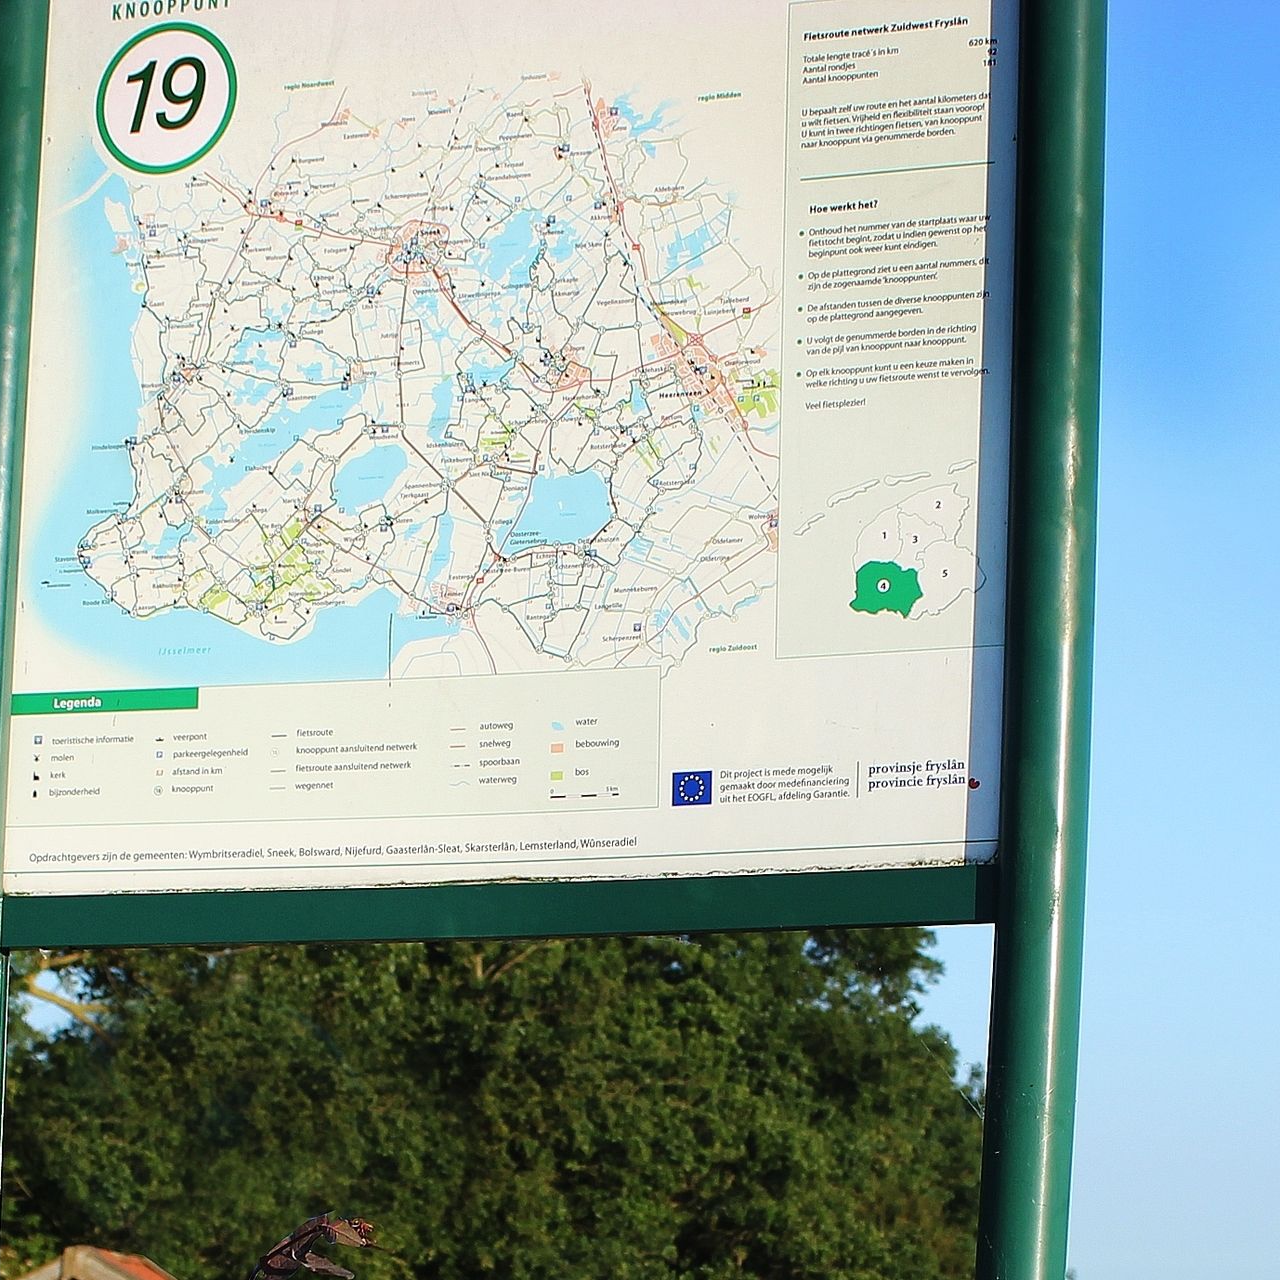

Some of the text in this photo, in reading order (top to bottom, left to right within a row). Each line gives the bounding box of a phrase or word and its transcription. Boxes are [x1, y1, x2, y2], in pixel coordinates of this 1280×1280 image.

[803, 29, 849, 42] Fietsroute
[851, 24, 889, 37] netwerk
[890, 20, 932, 33] Zuidwest
[968, 37, 983, 47] 620
[803, 53, 825, 63] Totale
[826, 51, 850, 62] lengte
[803, 61, 856, 74] Aantal rondjes
[802, 70, 879, 85] Aantal knooppunten
[127, 56, 207, 134] 19
[809, 105, 837, 117] bepaalt
[838, 104, 852, 113] zelf
[866, 101, 886, 111] route
[898, 99, 911, 108] het
[912, 96, 936, 107] aantal
[937, 94, 977, 104] kilometers
[807, 118, 822, 127] wilt
[851, 112, 880, 124] Vrijheid
[893, 108, 932, 119] flexibiliteit
[933, 107, 954, 116] staan
[808, 128, 825, 138] kunt
[834, 127, 854, 135] twee
[855, 123, 894, 133] richtingen
[924, 119, 938, 127] van
[939, 114, 983, 126] knooppunt
[801, 141, 817, 149] naar
[818, 136, 860, 148] knooppunt
[861, 135, 872, 144] via
[873, 130, 925, 145] genummerde
[810, 199, 878, 214] Hoe werkt het?
[829, 309, 874, 323] plattegrond
[806, 348, 820, 356] van
[832, 344, 844, 356] pijl
[845, 345, 859, 353] van
[860, 340, 902, 352] knooppunt
[904, 340, 921, 348] naar
[806, 400, 821, 410] Veel
[936, 501, 941, 509] 2
[942, 569, 948, 578] 5
[880, 582, 886, 590] 4
[53, 697, 102, 711] Legenda
[480, 721, 514, 731] autoweg
[576, 717, 598, 726] water
[173, 733, 207, 742] veerpont
[297, 728, 334, 737] fietsroute
[52, 733, 134, 745] toeristische informatie
[479, 739, 511, 749] snelweg
[576, 738, 620, 748] bebouwing
[173, 749, 248, 759] parkeergelegenheid
[296, 741, 417, 756] knooppunt aansluitend netwerk
[51, 754, 75, 762] molen
[479, 757, 520, 767] spoorbaan
[172, 765, 223, 776] afstand in km
[295, 759, 412, 773] fietsroute aansluitend netwerk
[575, 768, 590, 776] bos
[868, 758, 965, 777] provinsje fryslân
[50, 771, 66, 779] kerk
[720, 769, 732, 780] Dit
[733, 768, 762, 781] project
[772, 766, 795, 777] mede
[797, 764, 833, 777] mogelijk
[295, 781, 334, 791] wegennet
[479, 776, 517, 785] waterweg
[720, 776, 850, 794] gemaakt door medefinanciering
[868, 773, 966, 792] provincie fryslân
[49, 787, 100, 798] bijzonderheid
[172, 784, 214, 794] knooppunt
[720, 793, 730, 803] uit
[732, 792, 745, 803] het
[778, 790, 811, 802] afdeling
[813, 788, 850, 799] Garantie.
[29, 850, 99, 866] Opdrachtgevers
[101, 849, 117, 864] zijn
[119, 849, 131, 861] de
[133, 849, 187, 863] gemeenten:
[188, 845, 264, 861] Wymbritseradiel,
[266, 844, 296, 857] Sneek,
[298, 843, 342, 856] Bolsward,
[344, 842, 383, 857] Nijefurd,
[519, 836, 579, 849] Lemsterland,
[579, 834, 638, 848] Wûnseradiel
